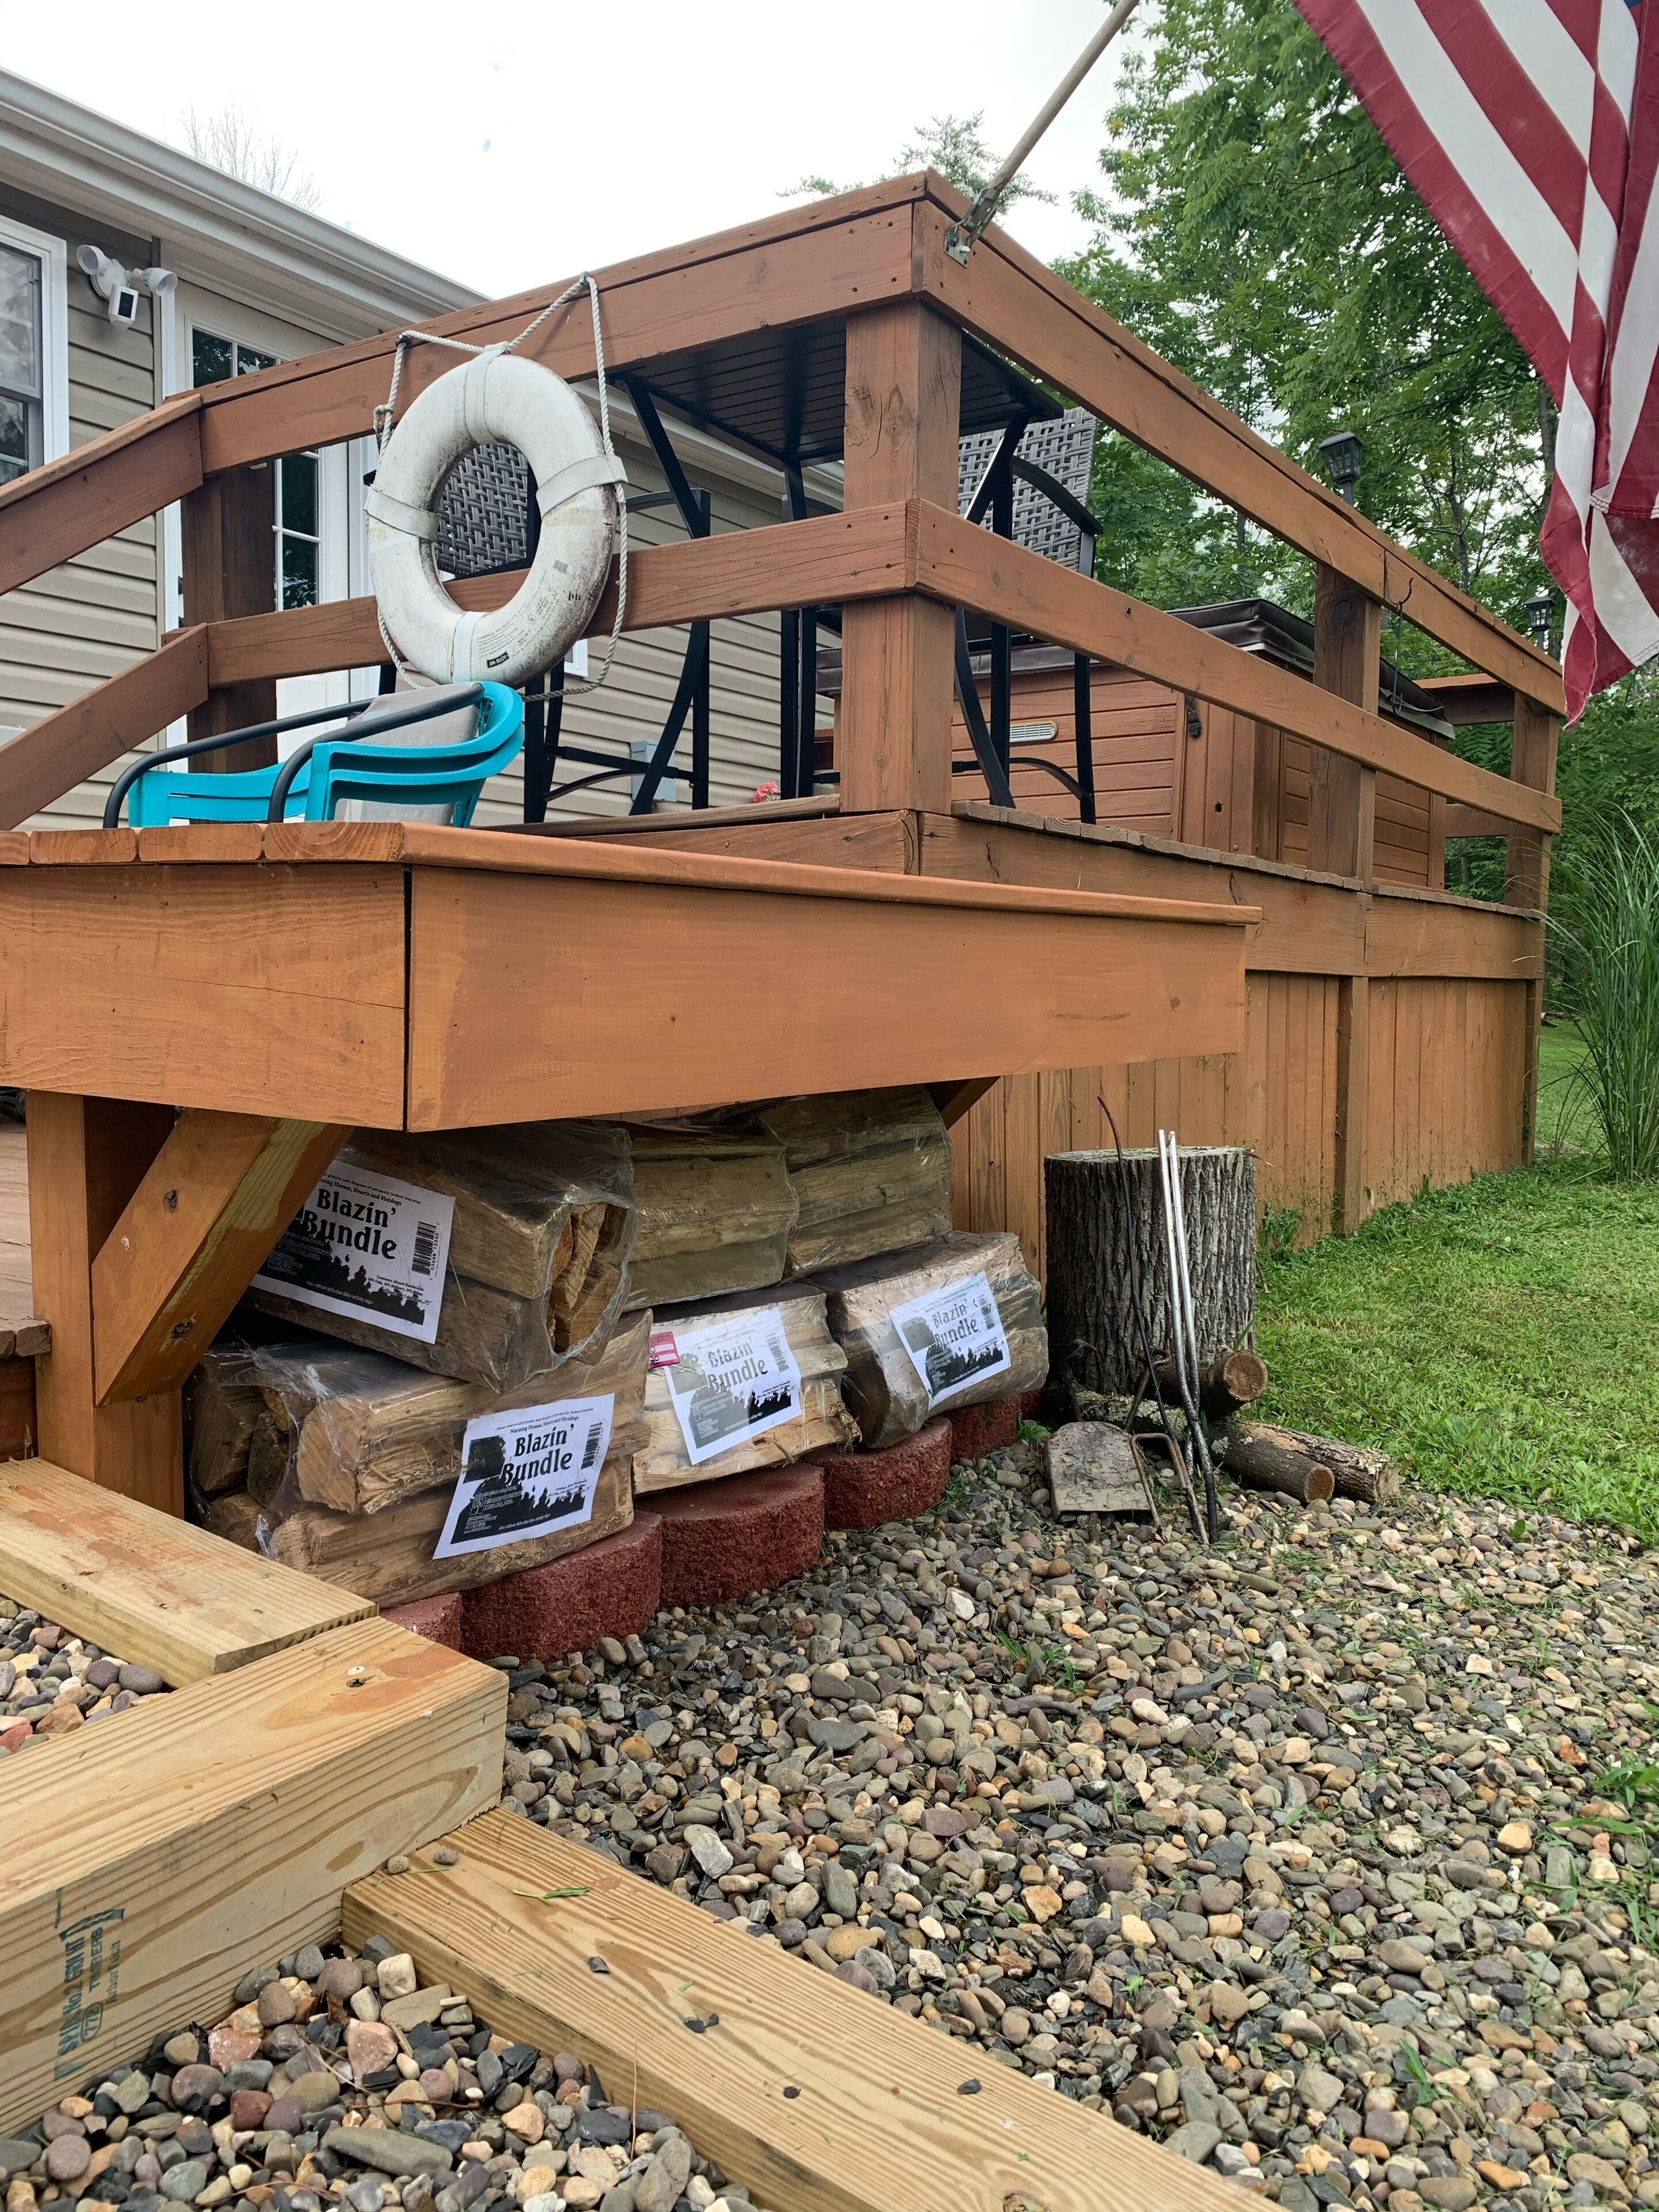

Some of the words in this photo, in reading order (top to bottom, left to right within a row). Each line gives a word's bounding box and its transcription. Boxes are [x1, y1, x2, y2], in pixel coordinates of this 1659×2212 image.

[317, 1188, 396, 1228] Blazin'
[334, 1181, 353, 1192] Homes,
[353, 1187, 369, 1197] Hearts
[381, 1195, 402, 1206] Hotdogs
[302, 1210, 397, 1260] Bundle
[934, 1318, 979, 1349] Bundle
[707, 1359, 768, 1392] Bundle
[514, 1423, 574, 1457] Blazin'
[501, 1448, 572, 1483] Bundle
[65, 1937, 85, 1956] HT
[89, 1927, 103, 1993] TIMBERS
